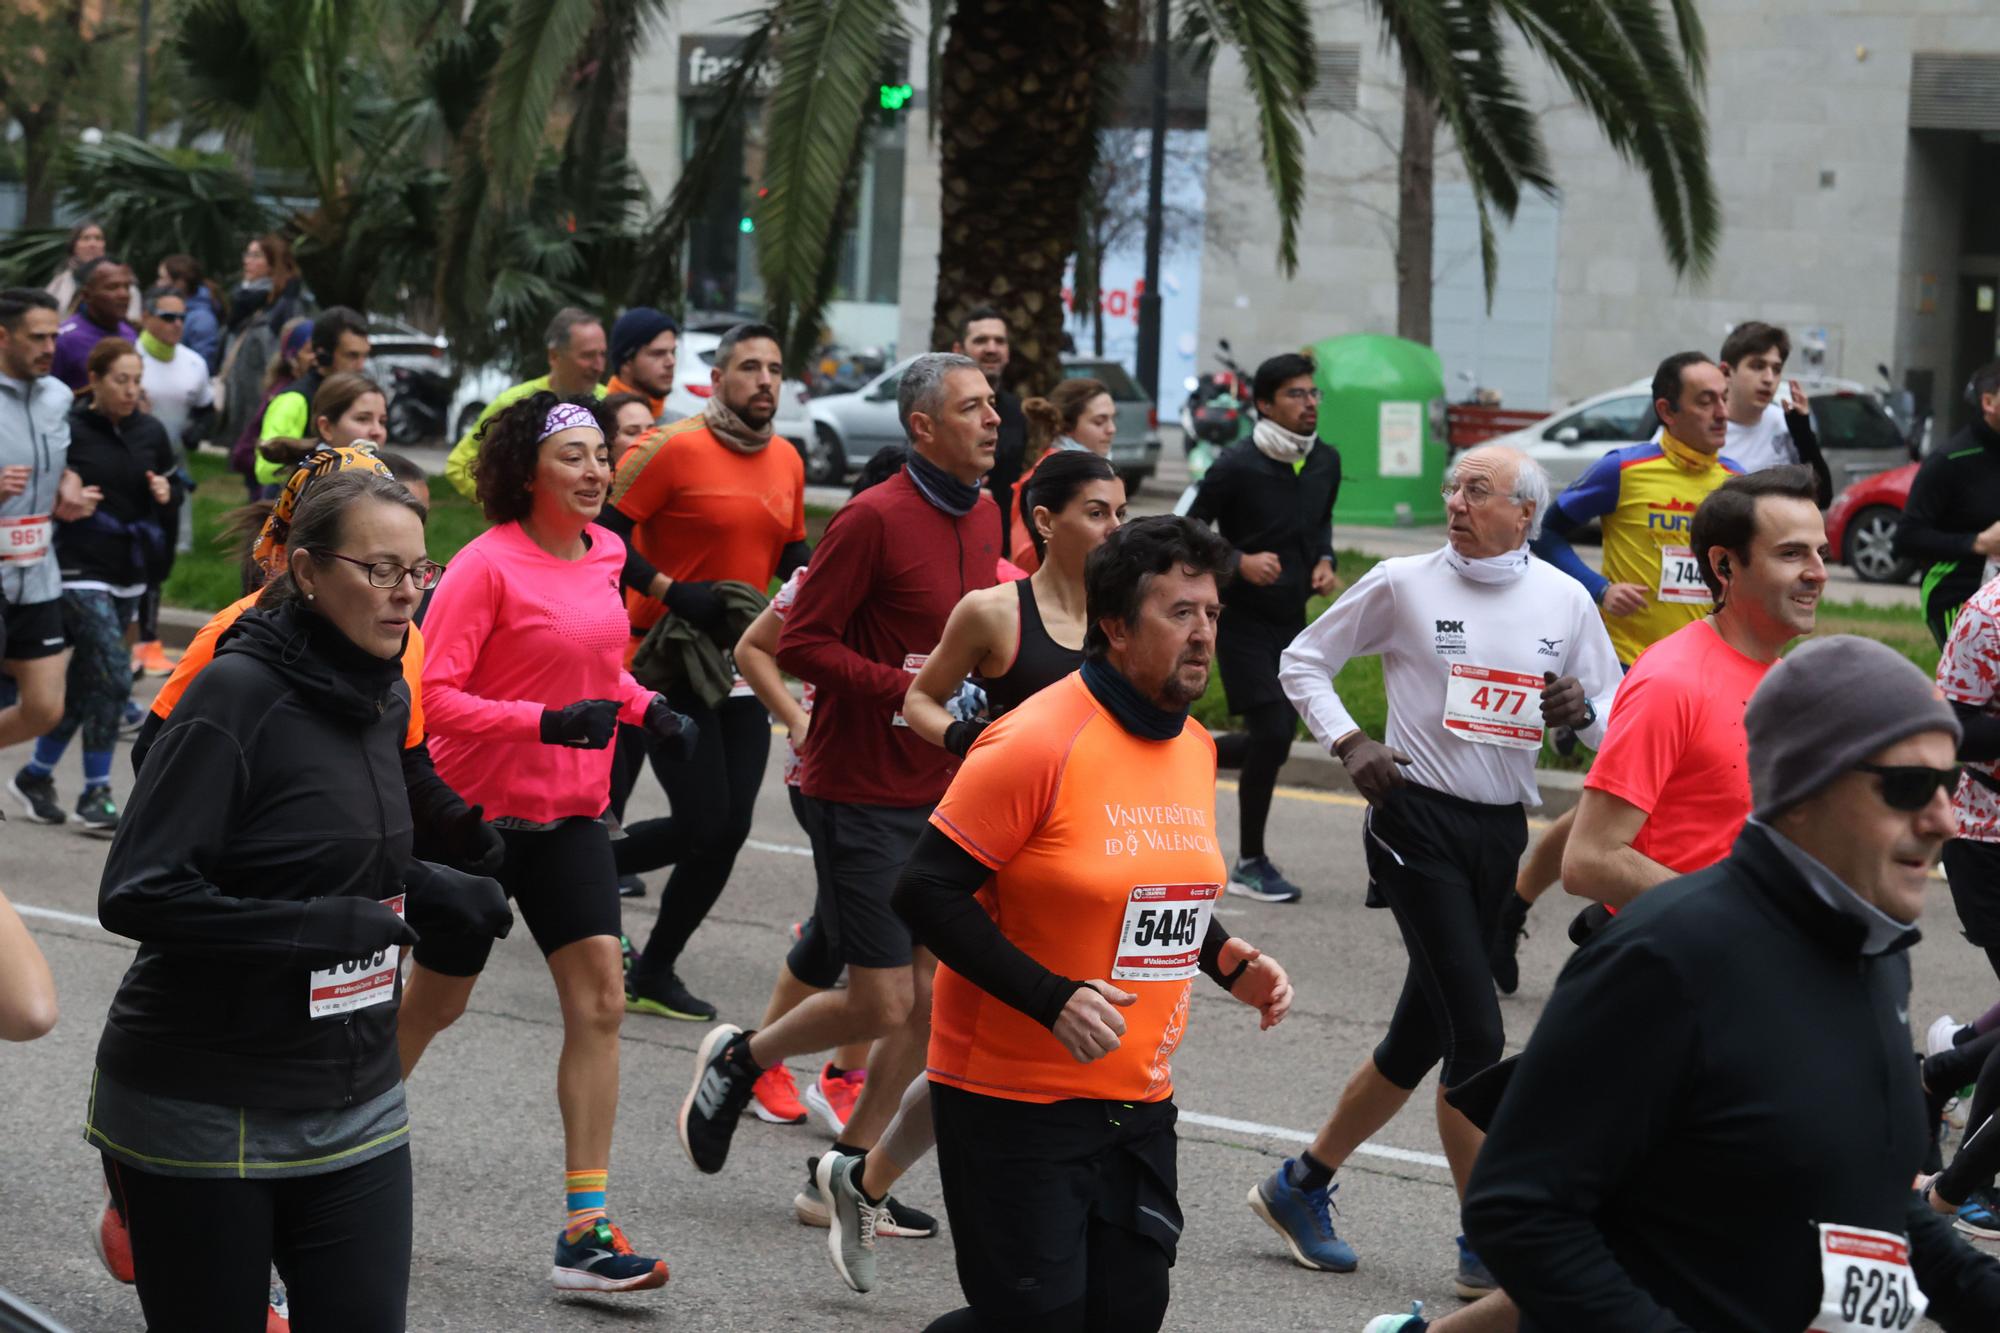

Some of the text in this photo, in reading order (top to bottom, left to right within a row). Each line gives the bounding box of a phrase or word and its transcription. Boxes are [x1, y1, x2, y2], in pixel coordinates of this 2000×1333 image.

[1676, 562, 1703, 584] 744
[1436, 620, 1464, 633] 10K
[1471, 686, 1527, 715] 477
[1135, 908, 1199, 947] 5445
